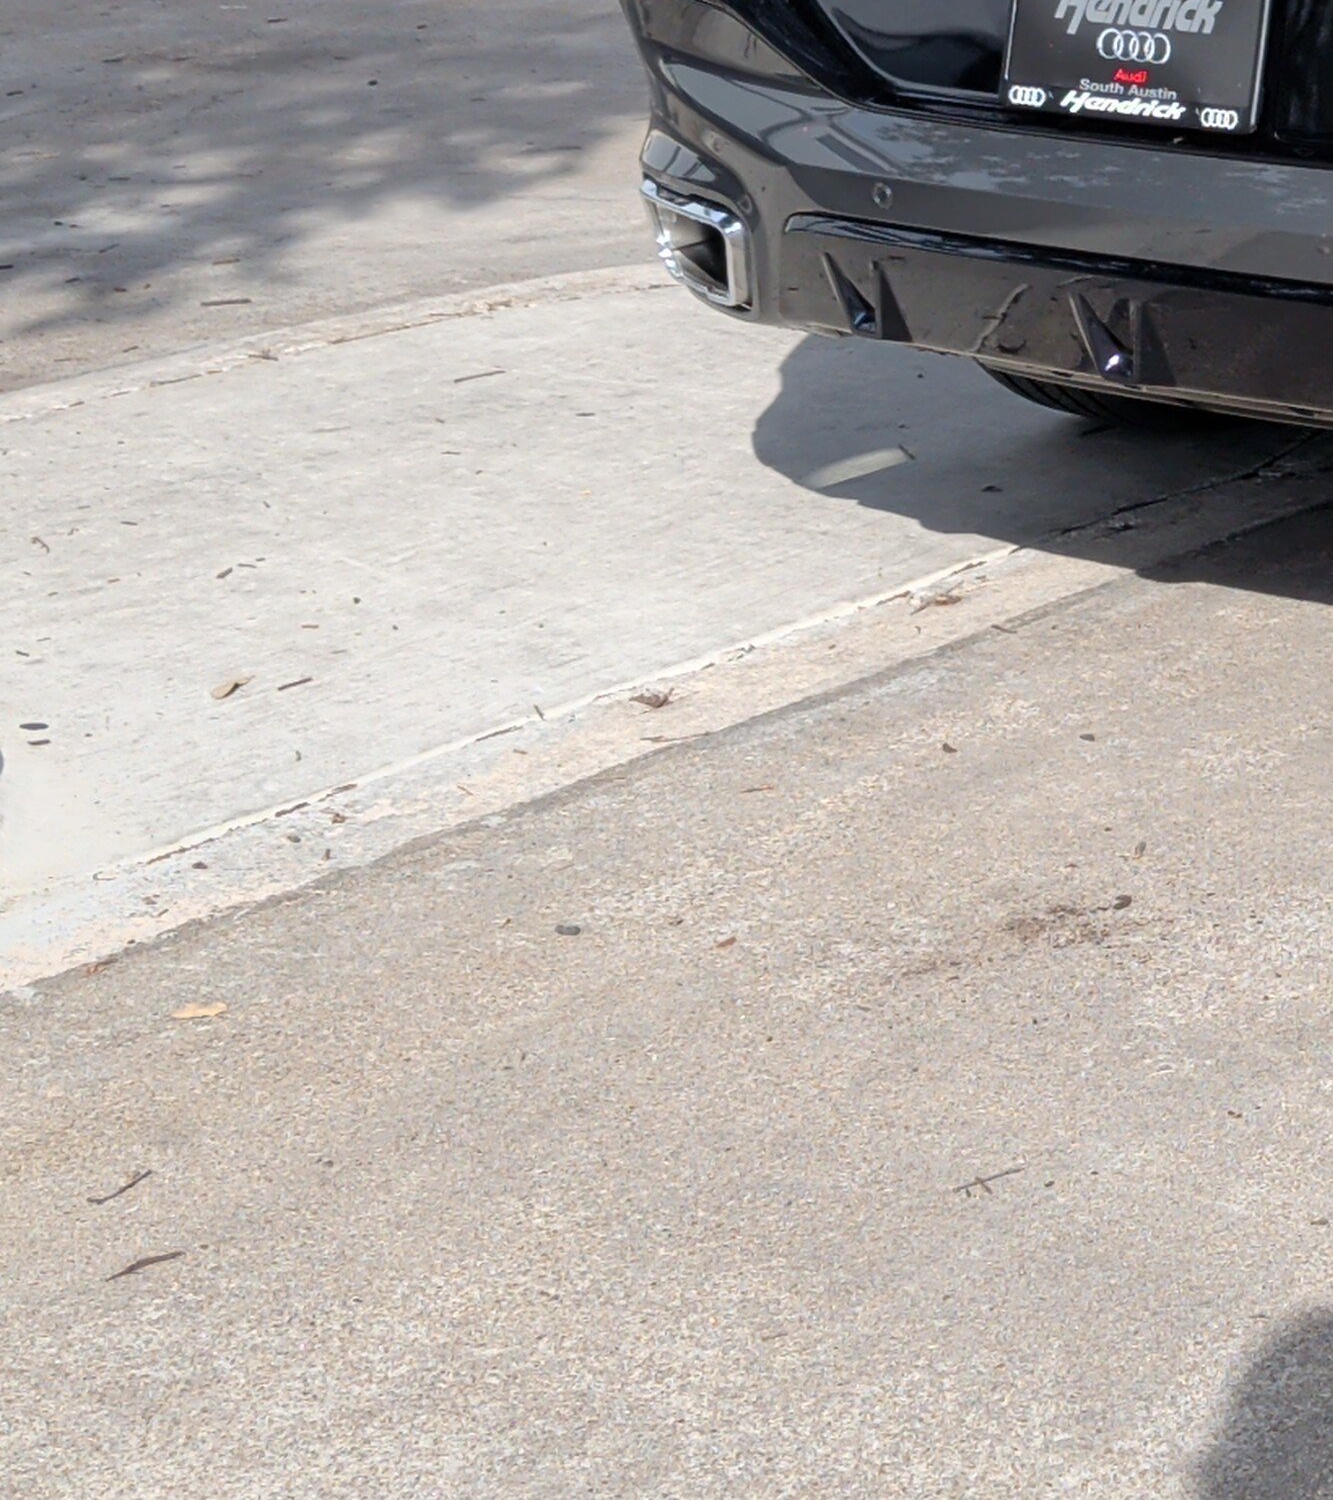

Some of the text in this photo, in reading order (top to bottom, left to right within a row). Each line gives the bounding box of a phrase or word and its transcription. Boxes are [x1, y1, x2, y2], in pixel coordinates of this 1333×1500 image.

[1113, 67, 1148, 84] Audi
[1079, 77, 1177, 101] South Austin
[1060, 89, 1187, 121] Hendrick
